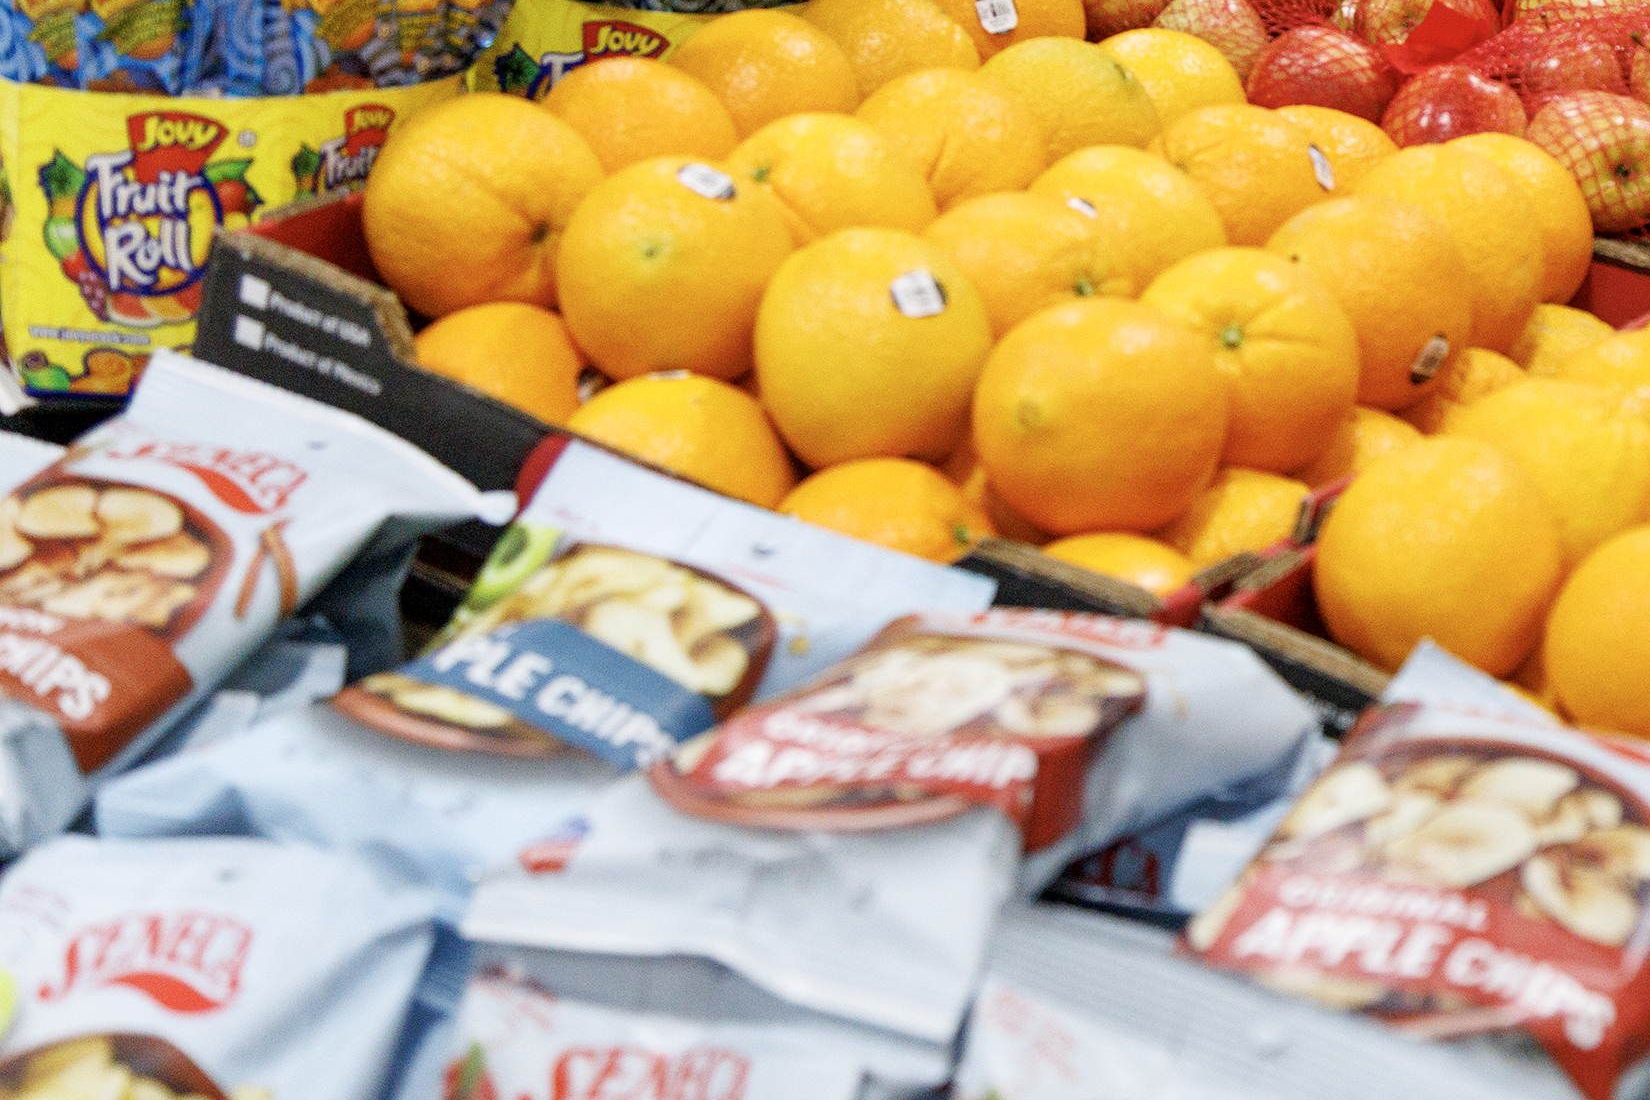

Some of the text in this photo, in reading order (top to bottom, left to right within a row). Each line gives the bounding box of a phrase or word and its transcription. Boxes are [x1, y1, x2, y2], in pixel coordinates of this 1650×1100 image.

[87, 149, 202, 219] Fruit
[103, 219, 195, 290] Roll
[0, 635, 111, 719] HIPS
[1231, 906, 1618, 1051] APPLE CHIPS
